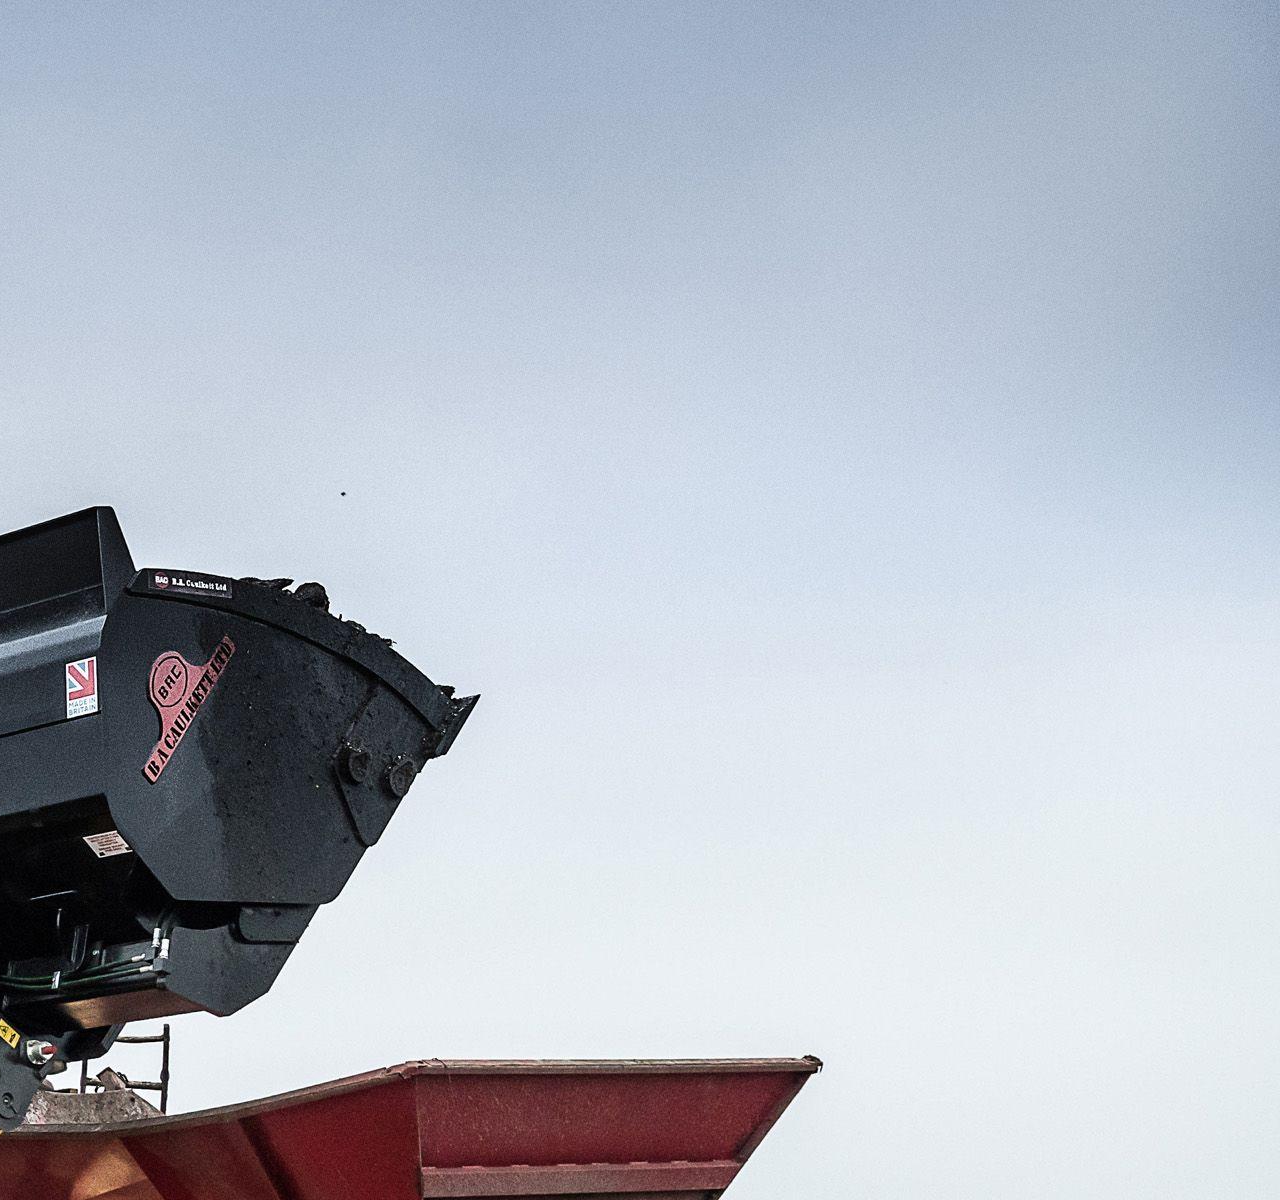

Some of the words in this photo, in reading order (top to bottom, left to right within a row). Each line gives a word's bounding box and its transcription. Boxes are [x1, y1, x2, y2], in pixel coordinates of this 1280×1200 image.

[158, 664, 182, 700] BAC
[68, 700, 87, 709] MADE
[68, 704, 96, 716] BRITAIN
[147, 760, 161, 777] B
[164, 669, 214, 750] CAULKETT
